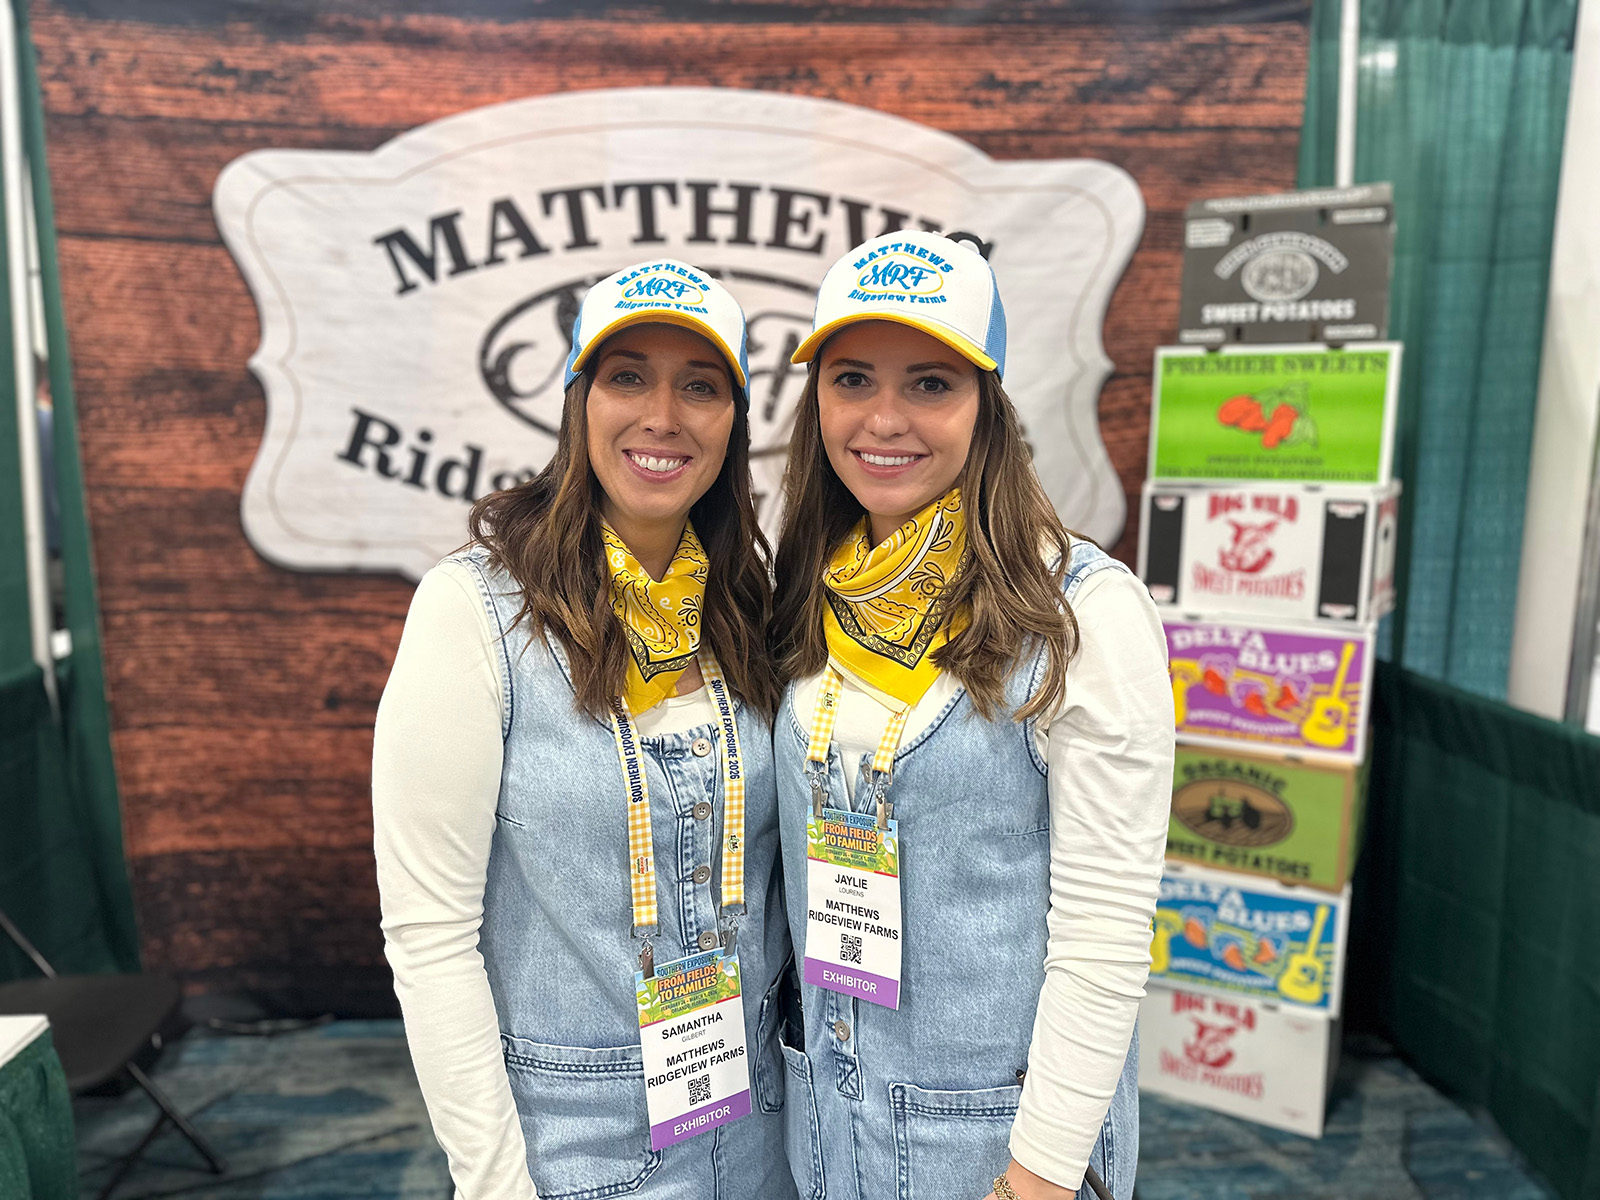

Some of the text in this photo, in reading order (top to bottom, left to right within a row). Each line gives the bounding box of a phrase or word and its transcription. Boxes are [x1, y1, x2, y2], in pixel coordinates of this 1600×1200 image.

[853, 243, 954, 273] MATTHEWS
[616, 263, 711, 292] MATTHEWS
[624, 277, 697, 300] MRF
[859, 261, 937, 290] MRF
[614, 300, 709, 314] Ridgeview Farms
[848, 289, 948, 304] Ridgeview Farms
[1201, 299, 1356, 324] SWEET POTATOES
[1165, 354, 1386, 375] PREMIER SWEETS
[1252, 493, 1298, 523] WILD
[1192, 562, 1235, 594] SWEET
[1237, 567, 1306, 600] POTATOES
[1170, 626, 1267, 651] DELTA
[1239, 648, 1337, 675] BLUES
[616, 714, 636, 756] EXPOSURE
[711, 679, 740, 780] SOUTHERN EXPOSURE 2026
[625, 757, 644, 803] SOUTHERN
[1182, 761, 1288, 794] ORGANIC
[824, 811, 876, 828] SOUTHERN EXPOSURE
[825, 822, 878, 842] FROM FIELDS
[825, 834, 878, 854] TO FAMILIES
[1213, 845, 1312, 879] POTATOES
[834, 873, 868, 890] JAYLIE
[838, 887, 865, 898] LOURENS
[1160, 881, 1245, 908] DELTA
[825, 898, 880, 921] MATTHEWS
[1217, 905, 1312, 932] BLUES
[808, 909, 899, 940] RIDGEVIEW FARMS
[656, 953, 715, 977] SOUTHERN EXPOSURE
[658, 965, 717, 991] FROM FIELDS
[660, 975, 718, 1003] TO FAMILIES
[822, 969, 877, 995] EXHIBITOR
[661, 1011, 724, 1040] SAMANTHA
[681, 1029, 706, 1043] GILBERT
[666, 1038, 726, 1068] MATTHEWS
[647, 1046, 745, 1088] RIDGEVIEW FARMS
[1160, 1047, 1265, 1100] SWEET POTATOES
[673, 1105, 731, 1136] EXHIBITOR
